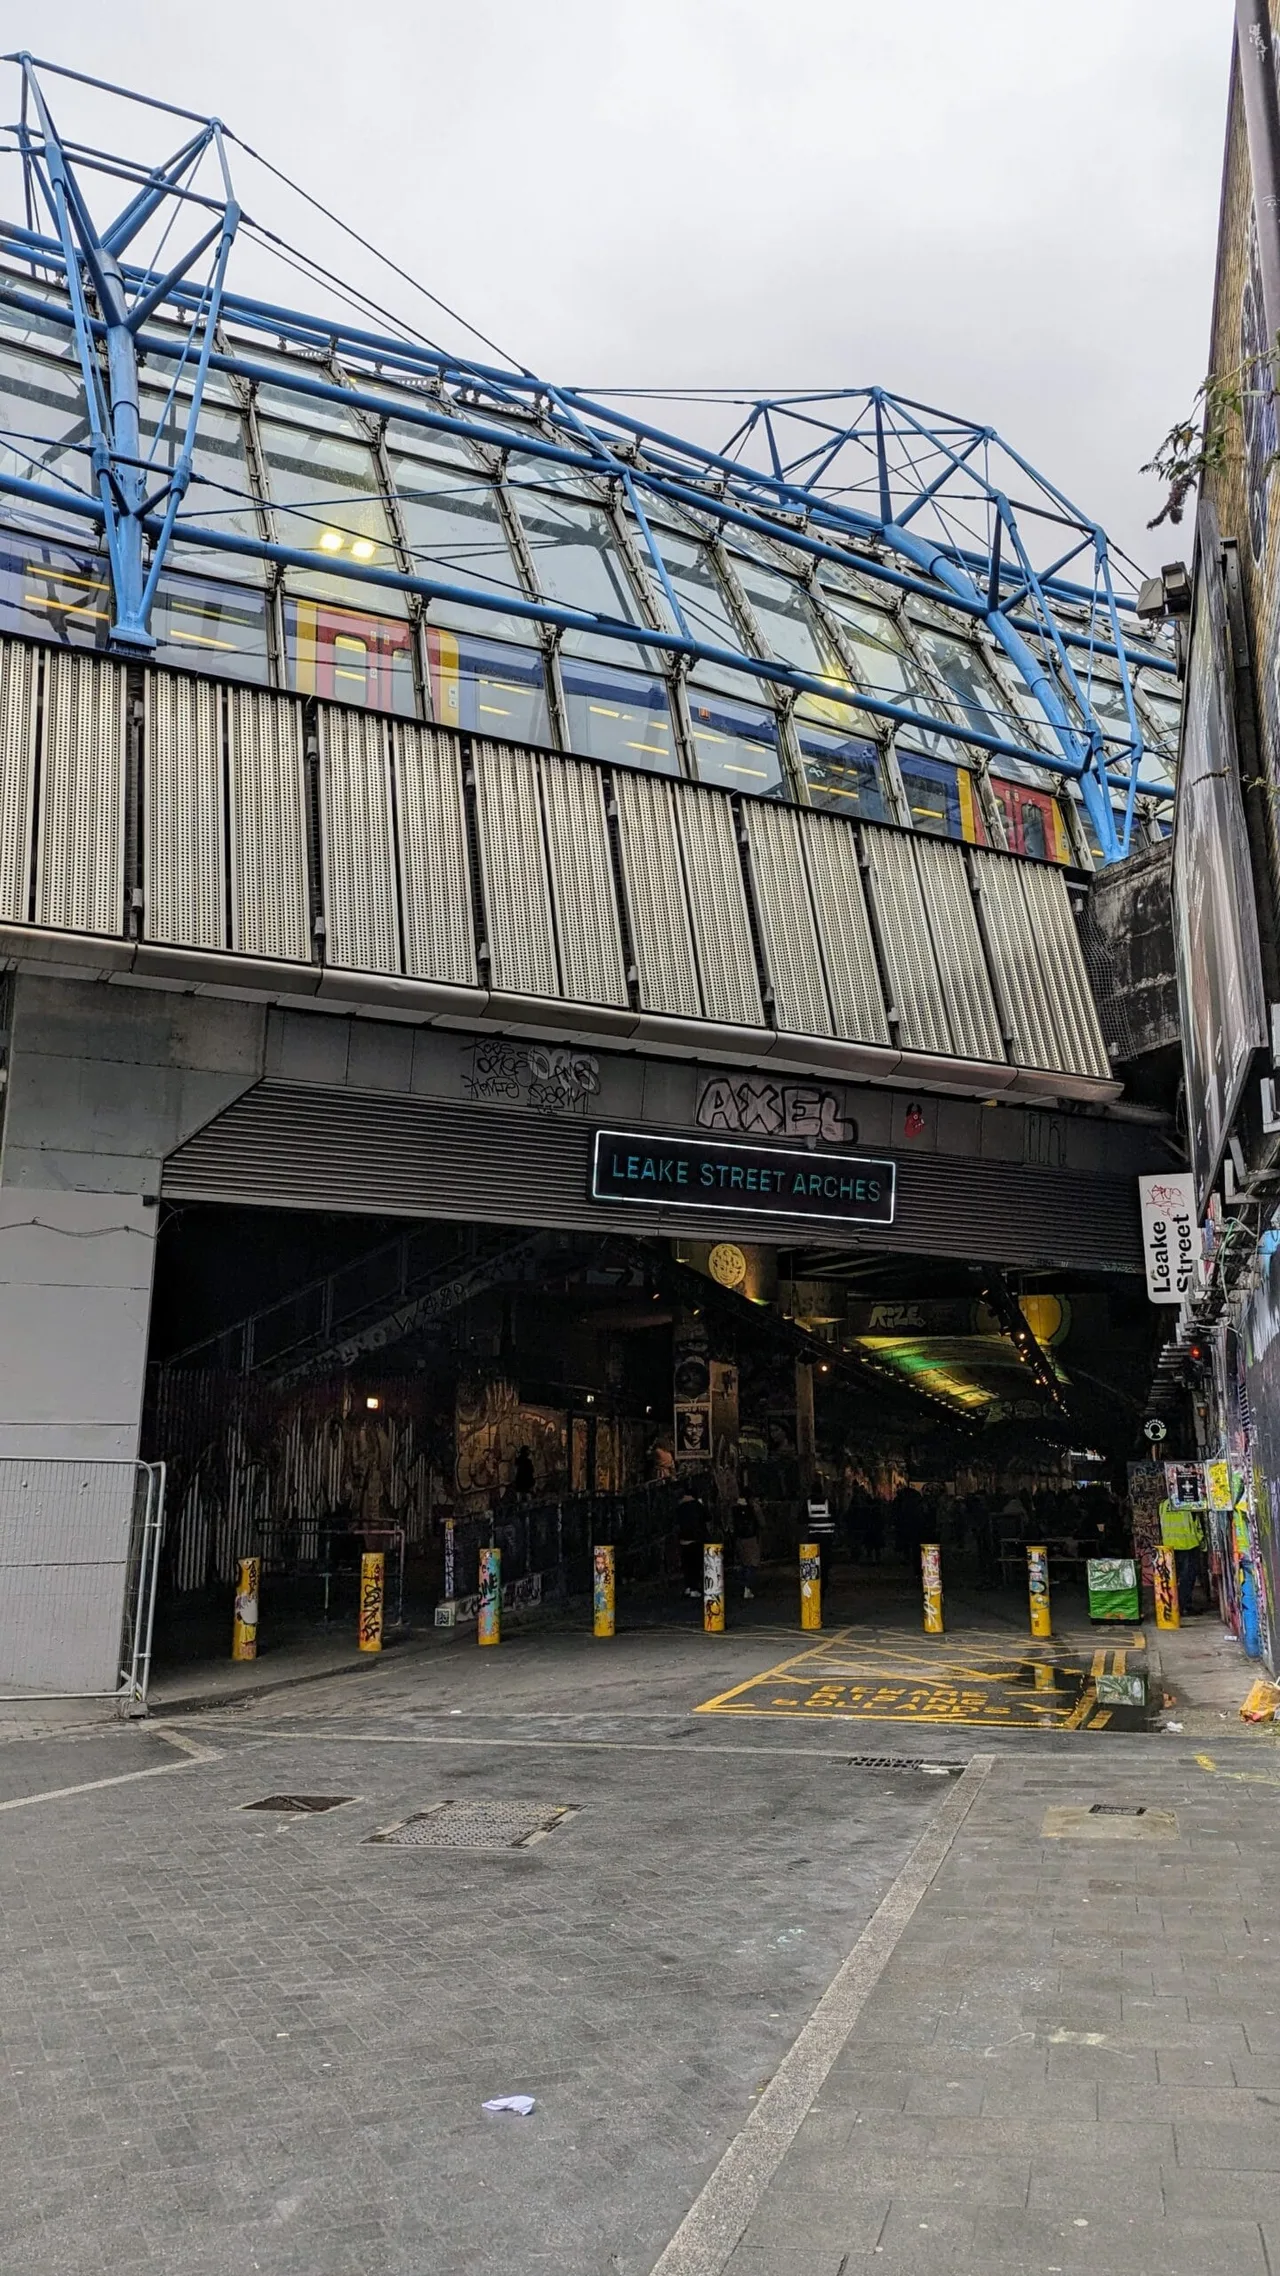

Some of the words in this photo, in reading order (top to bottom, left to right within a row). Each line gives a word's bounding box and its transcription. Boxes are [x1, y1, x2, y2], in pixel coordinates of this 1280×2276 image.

[696, 1077, 859, 1144] AXEL
[611, 1154, 689, 1184] LEAKE
[700, 1163, 786, 1194] STREET
[793, 1173, 881, 1202] ARCHES
[1150, 1221, 1171, 1292] Leake
[1172, 1213, 1193, 1293] Street
